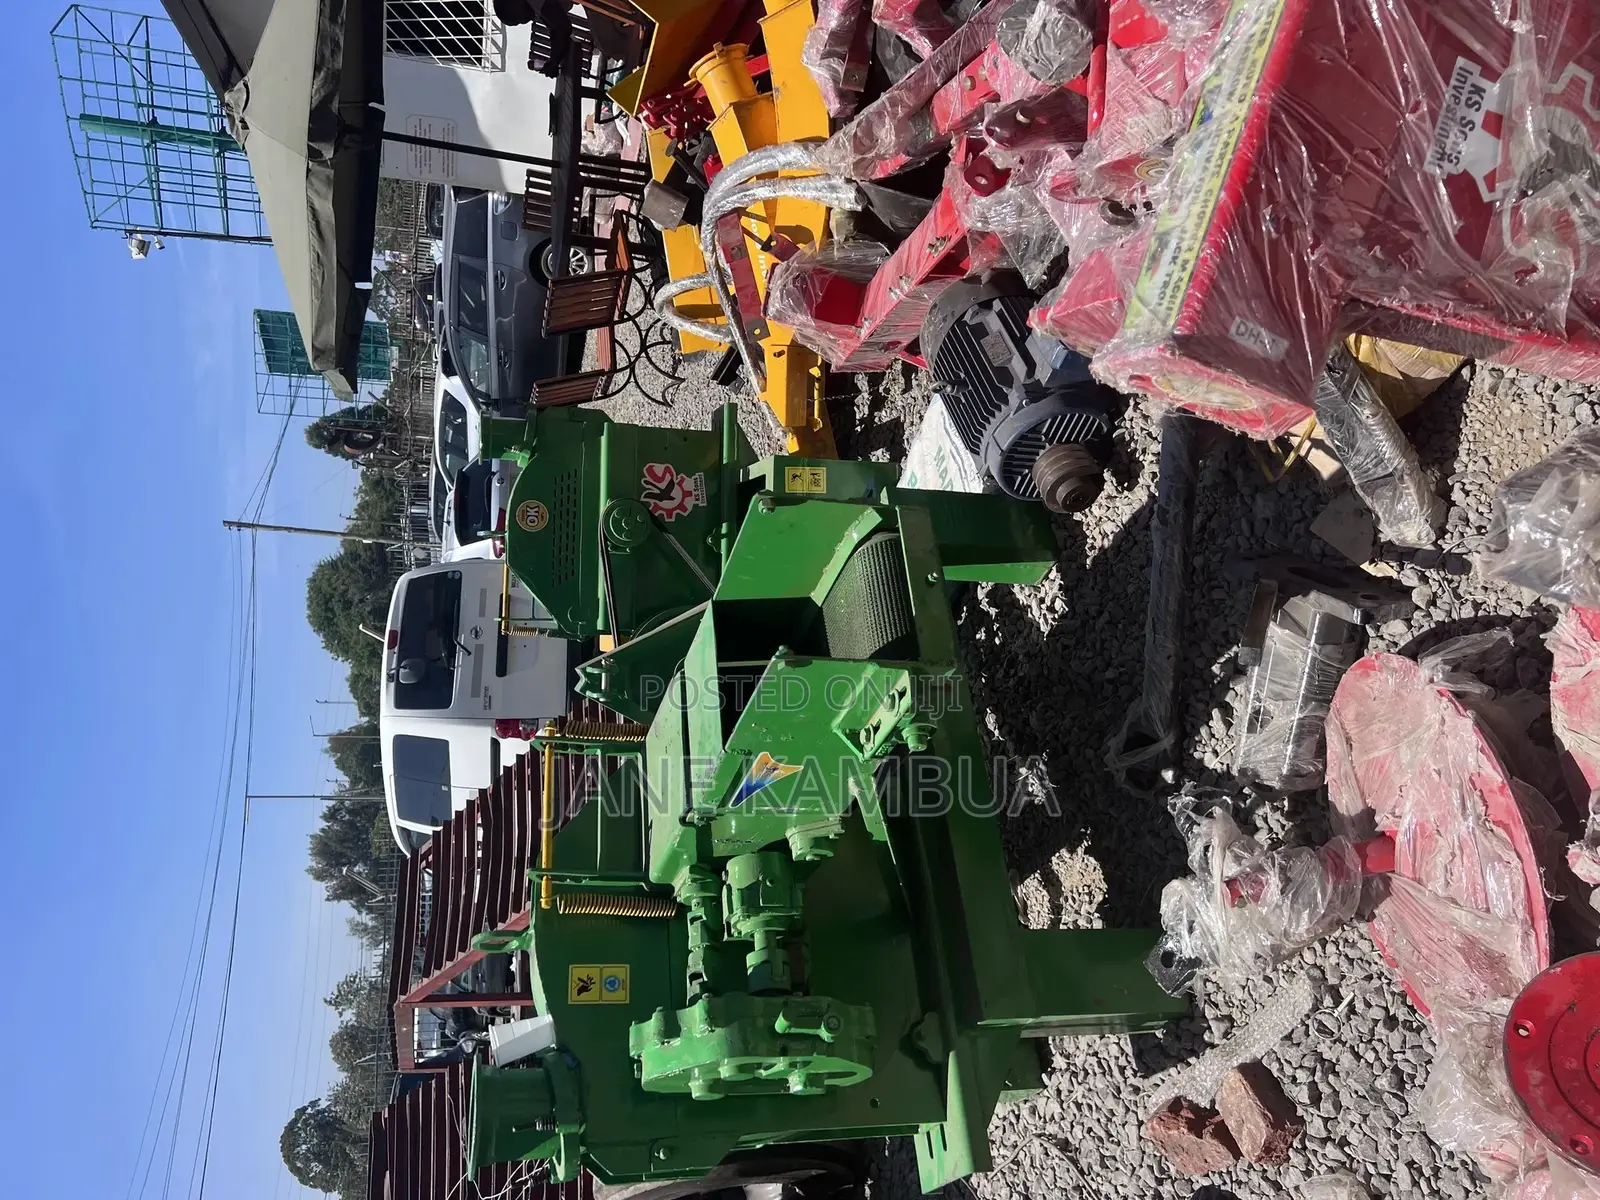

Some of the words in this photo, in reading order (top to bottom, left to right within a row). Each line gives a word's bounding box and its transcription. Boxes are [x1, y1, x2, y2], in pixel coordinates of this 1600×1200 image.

[1465, 83, 1486, 112] KS
[642, 464, 676, 503] KS
[525, 505, 539, 527] OK
